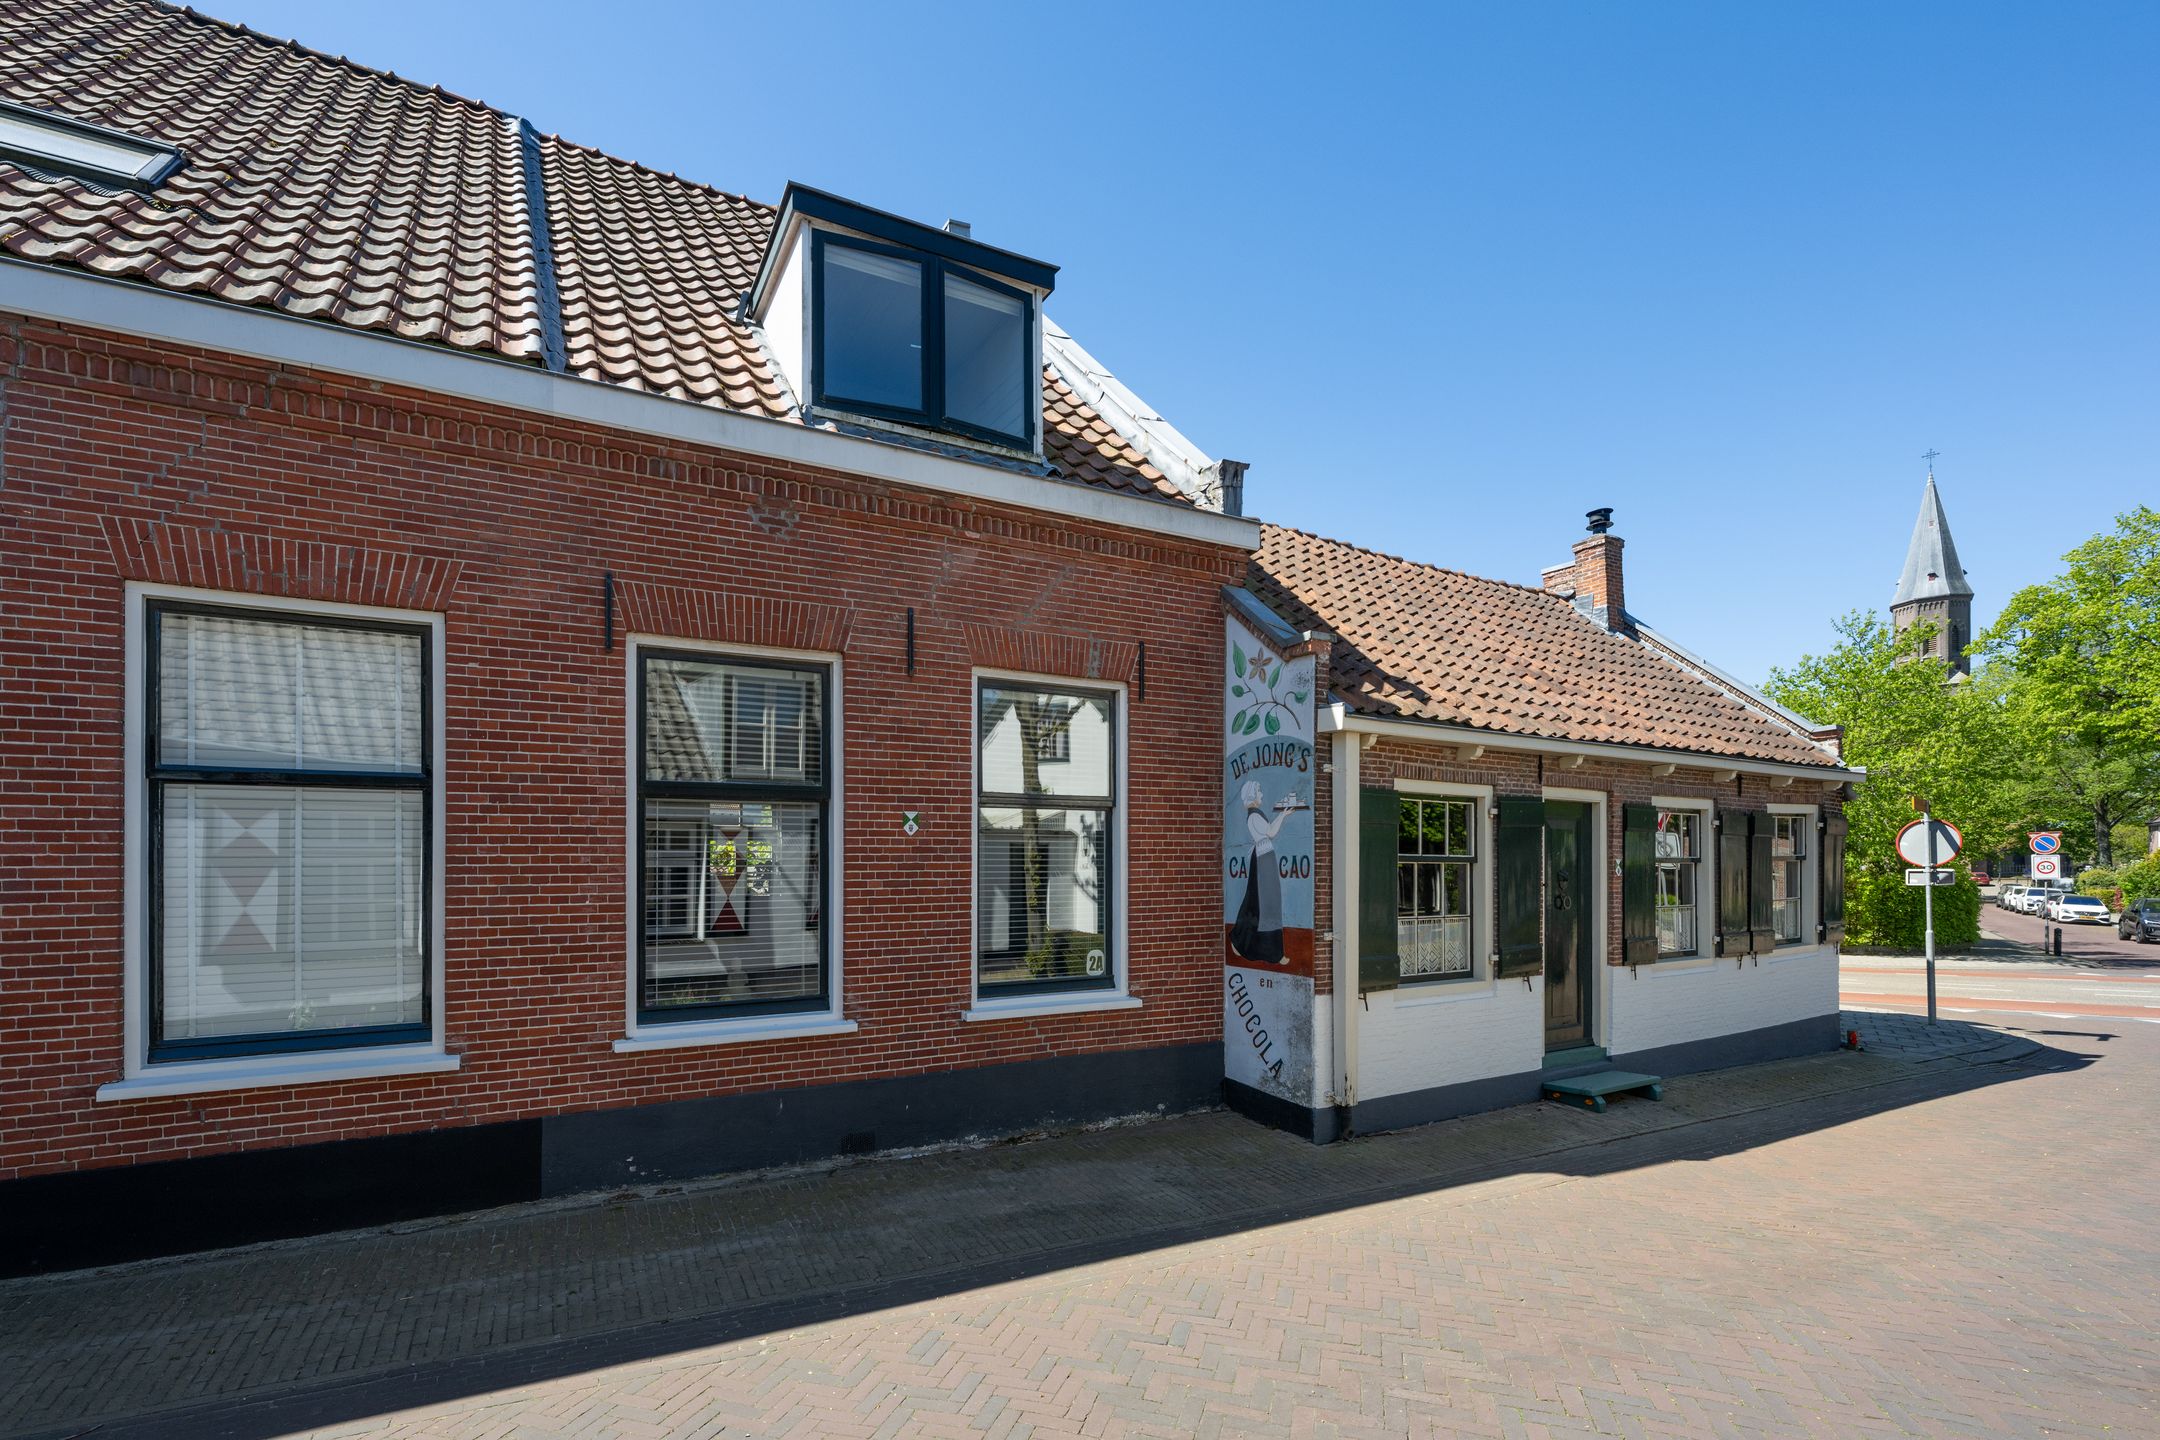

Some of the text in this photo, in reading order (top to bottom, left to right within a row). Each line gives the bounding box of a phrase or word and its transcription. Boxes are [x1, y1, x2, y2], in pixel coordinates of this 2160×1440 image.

[1230, 742, 1311, 780] DE JONG'S
[1229, 855, 1310, 879] CA CAO
[1089, 956, 1104, 971] 2A
[1259, 977, 1273, 988] en
[1228, 973, 1284, 1080] CHOCOLA
